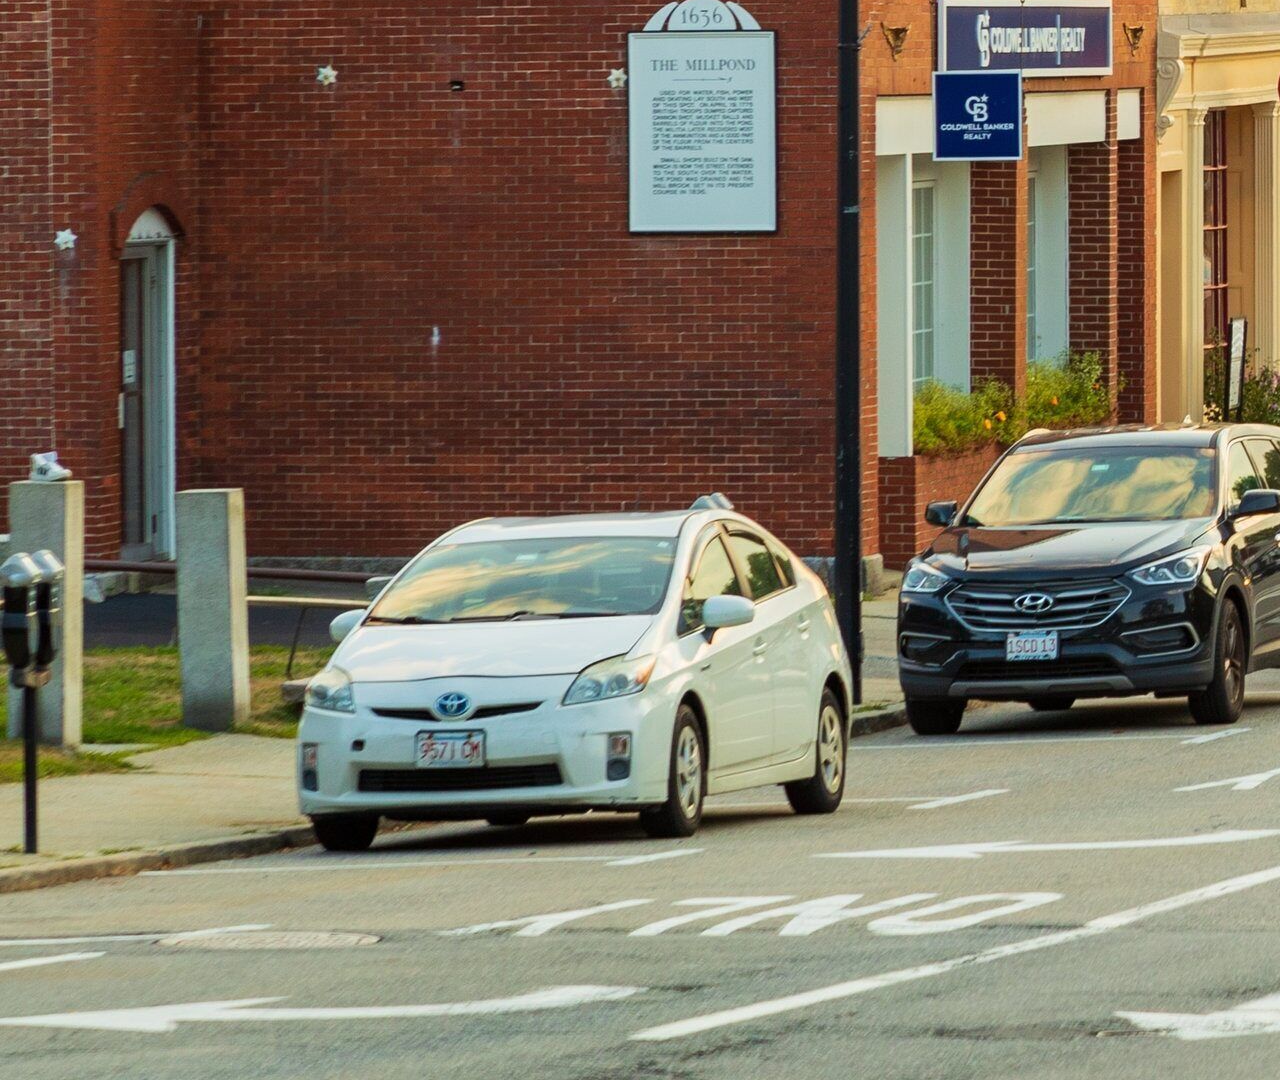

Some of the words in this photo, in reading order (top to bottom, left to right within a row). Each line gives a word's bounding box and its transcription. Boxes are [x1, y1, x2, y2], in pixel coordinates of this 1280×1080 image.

[681, 7, 723, 28] 1636
[991, 27, 1029, 53] COLDWELL
[1030, 27, 1057, 52] BANKER
[1060, 27, 1085, 52] REALTY
[650, 59, 677, 71] THE
[686, 59, 756, 71] MILLPOND
[940, 123, 982, 131] COLDWELL
[438, 891, 1064, 939] ONLY
